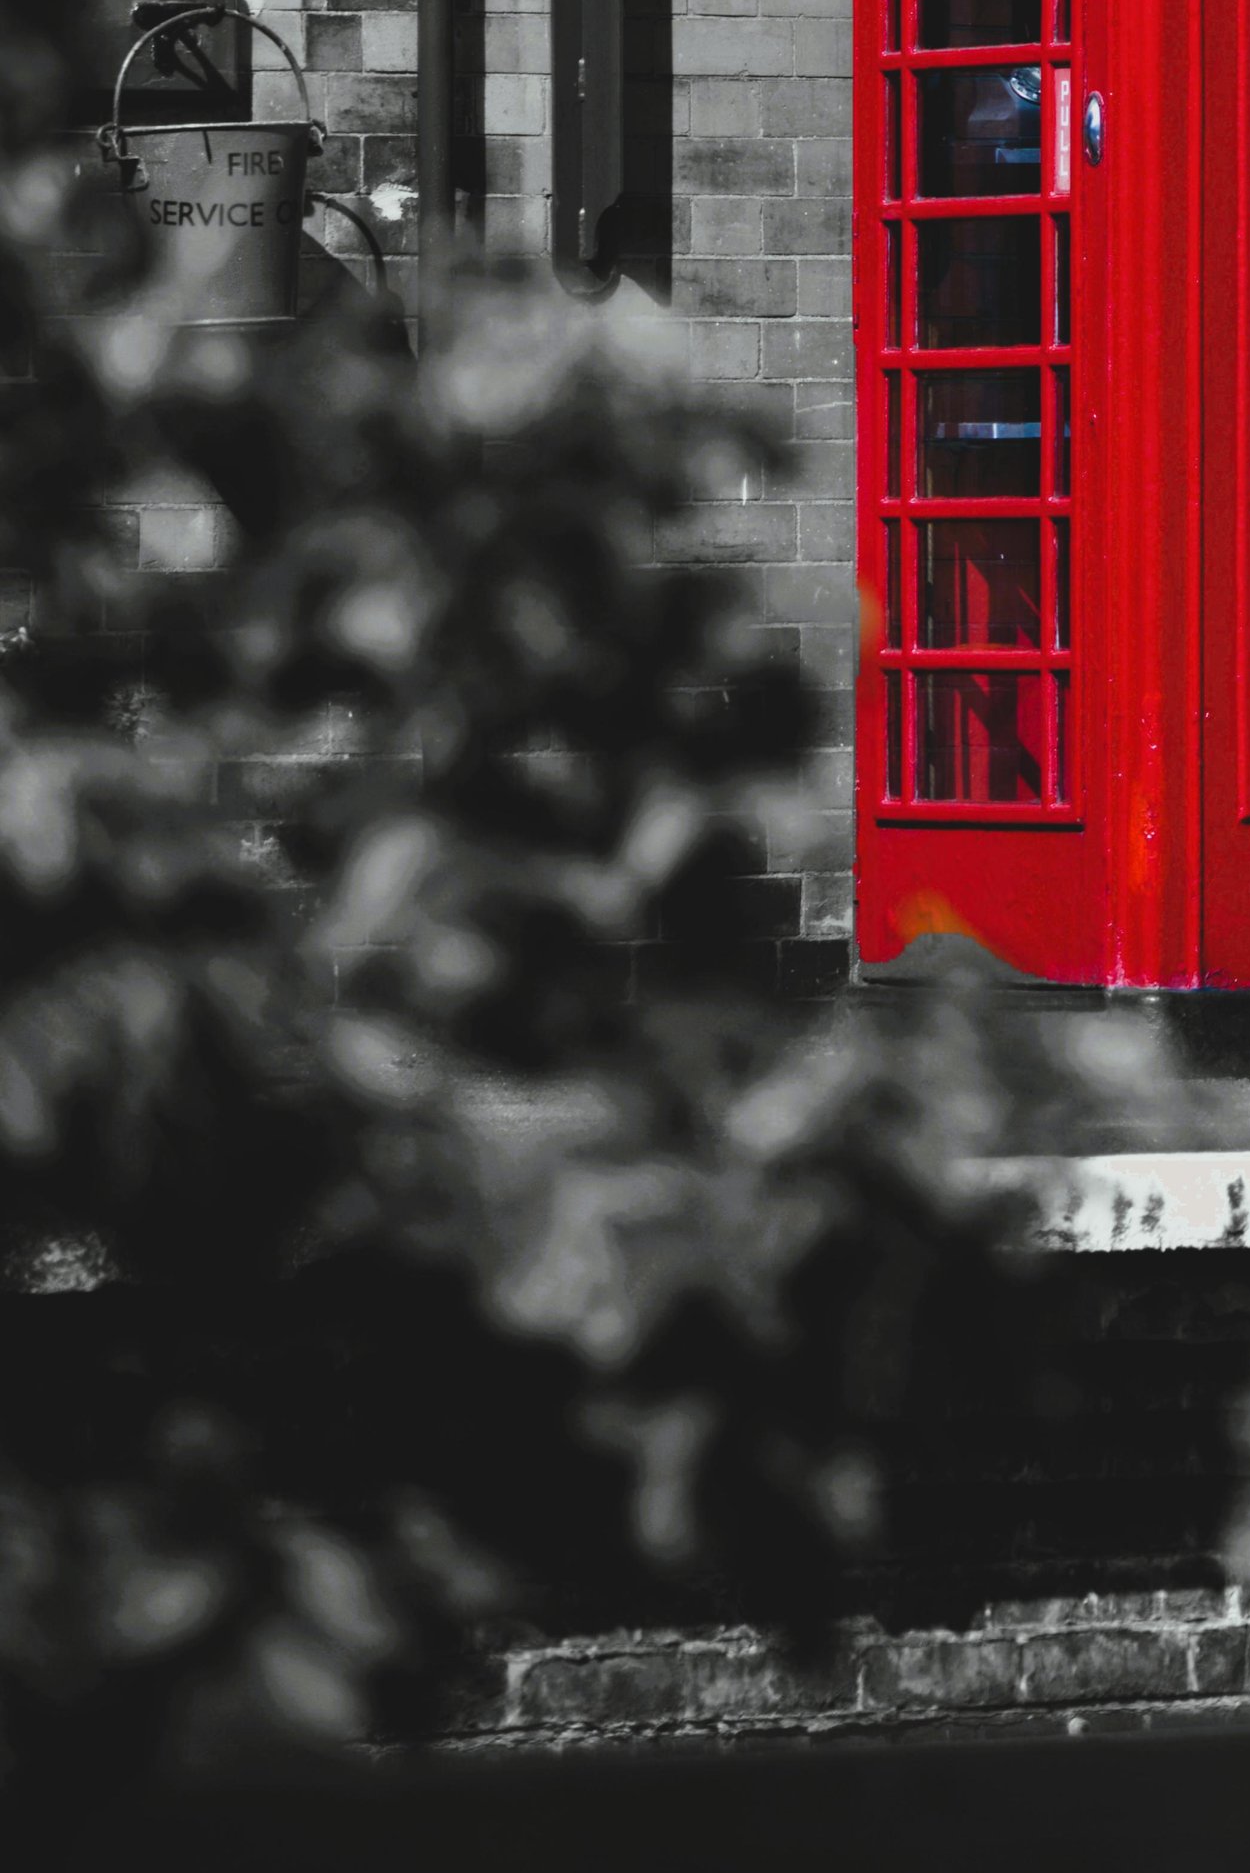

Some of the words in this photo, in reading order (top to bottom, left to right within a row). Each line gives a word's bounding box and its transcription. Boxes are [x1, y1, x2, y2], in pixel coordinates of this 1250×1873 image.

[1059, 80, 1070, 177] PULL
[227, 150, 281, 176] FIRE
[150, 198, 265, 227] SERVICE
